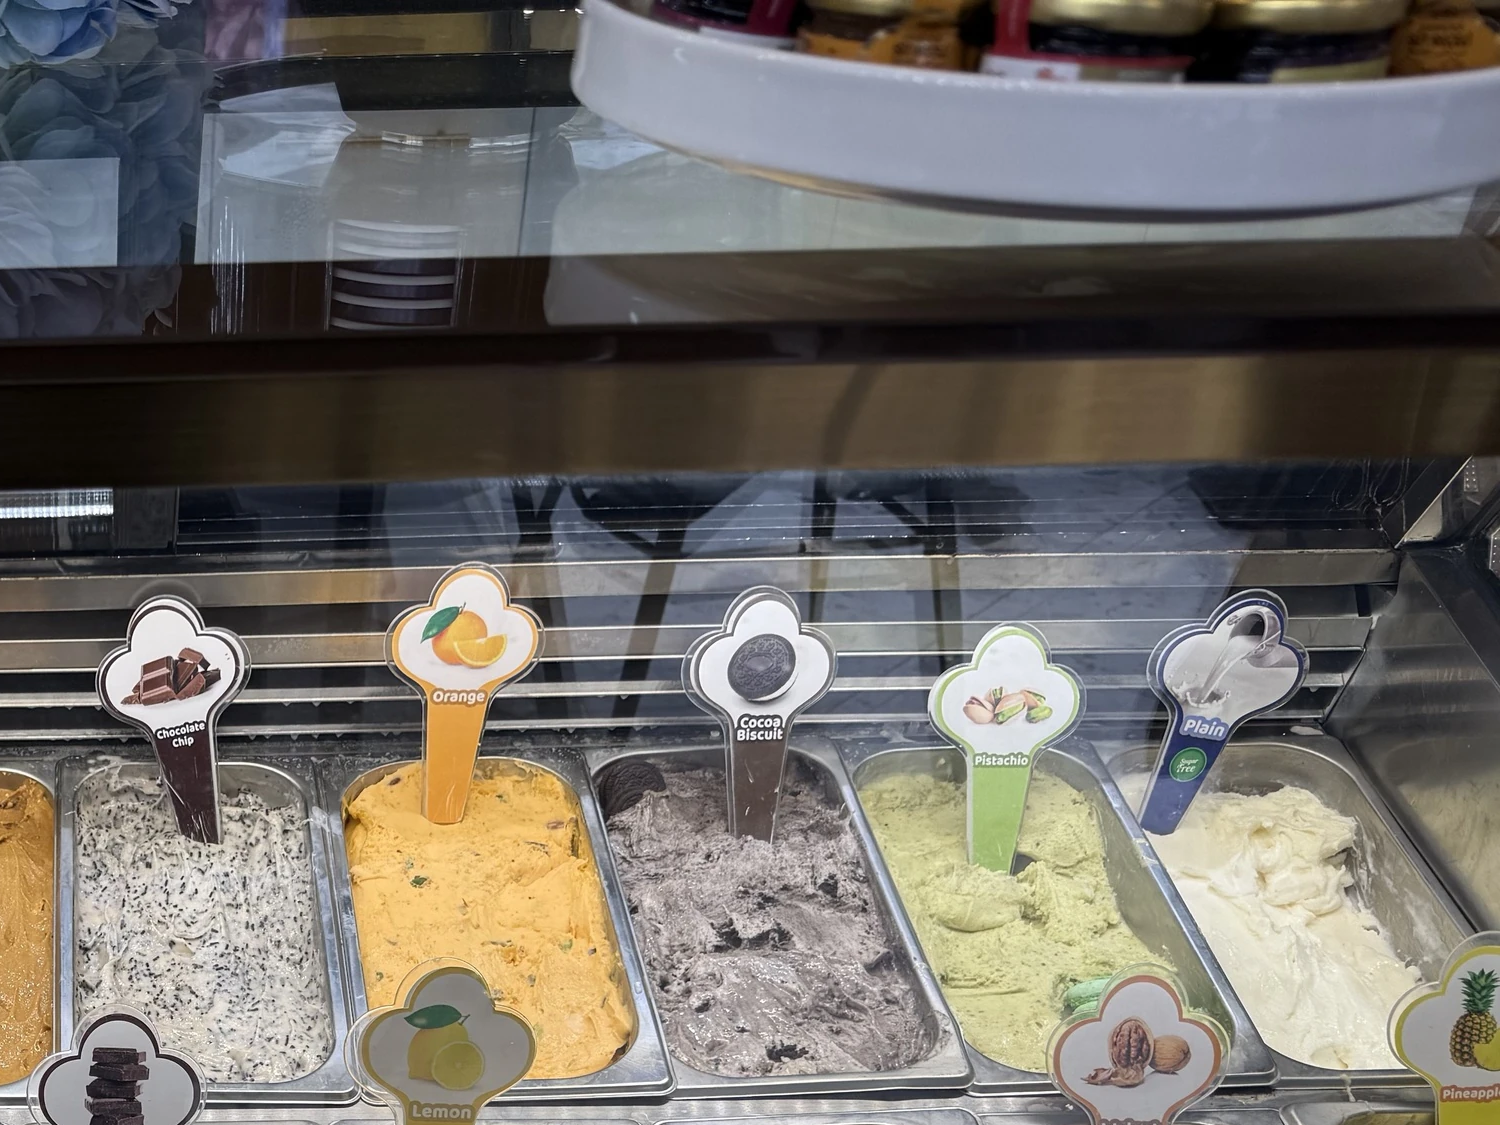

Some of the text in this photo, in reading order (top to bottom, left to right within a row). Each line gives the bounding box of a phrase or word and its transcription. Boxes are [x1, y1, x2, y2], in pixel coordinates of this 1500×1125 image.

[433, 691, 485, 705] Orange
[739, 716, 781, 728] Cocoa
[1183, 719, 1225, 739] Plain
[156, 721, 206, 740] Chocolate
[736, 728, 784, 742] Biscuit
[173, 735, 195, 748] Chip
[975, 753, 1029, 767] Pistachio
[1176, 764, 1196, 773] Free
[1443, 1086, 1500, 1100] Pineappl
[412, 1105, 472, 1120] Lemon
